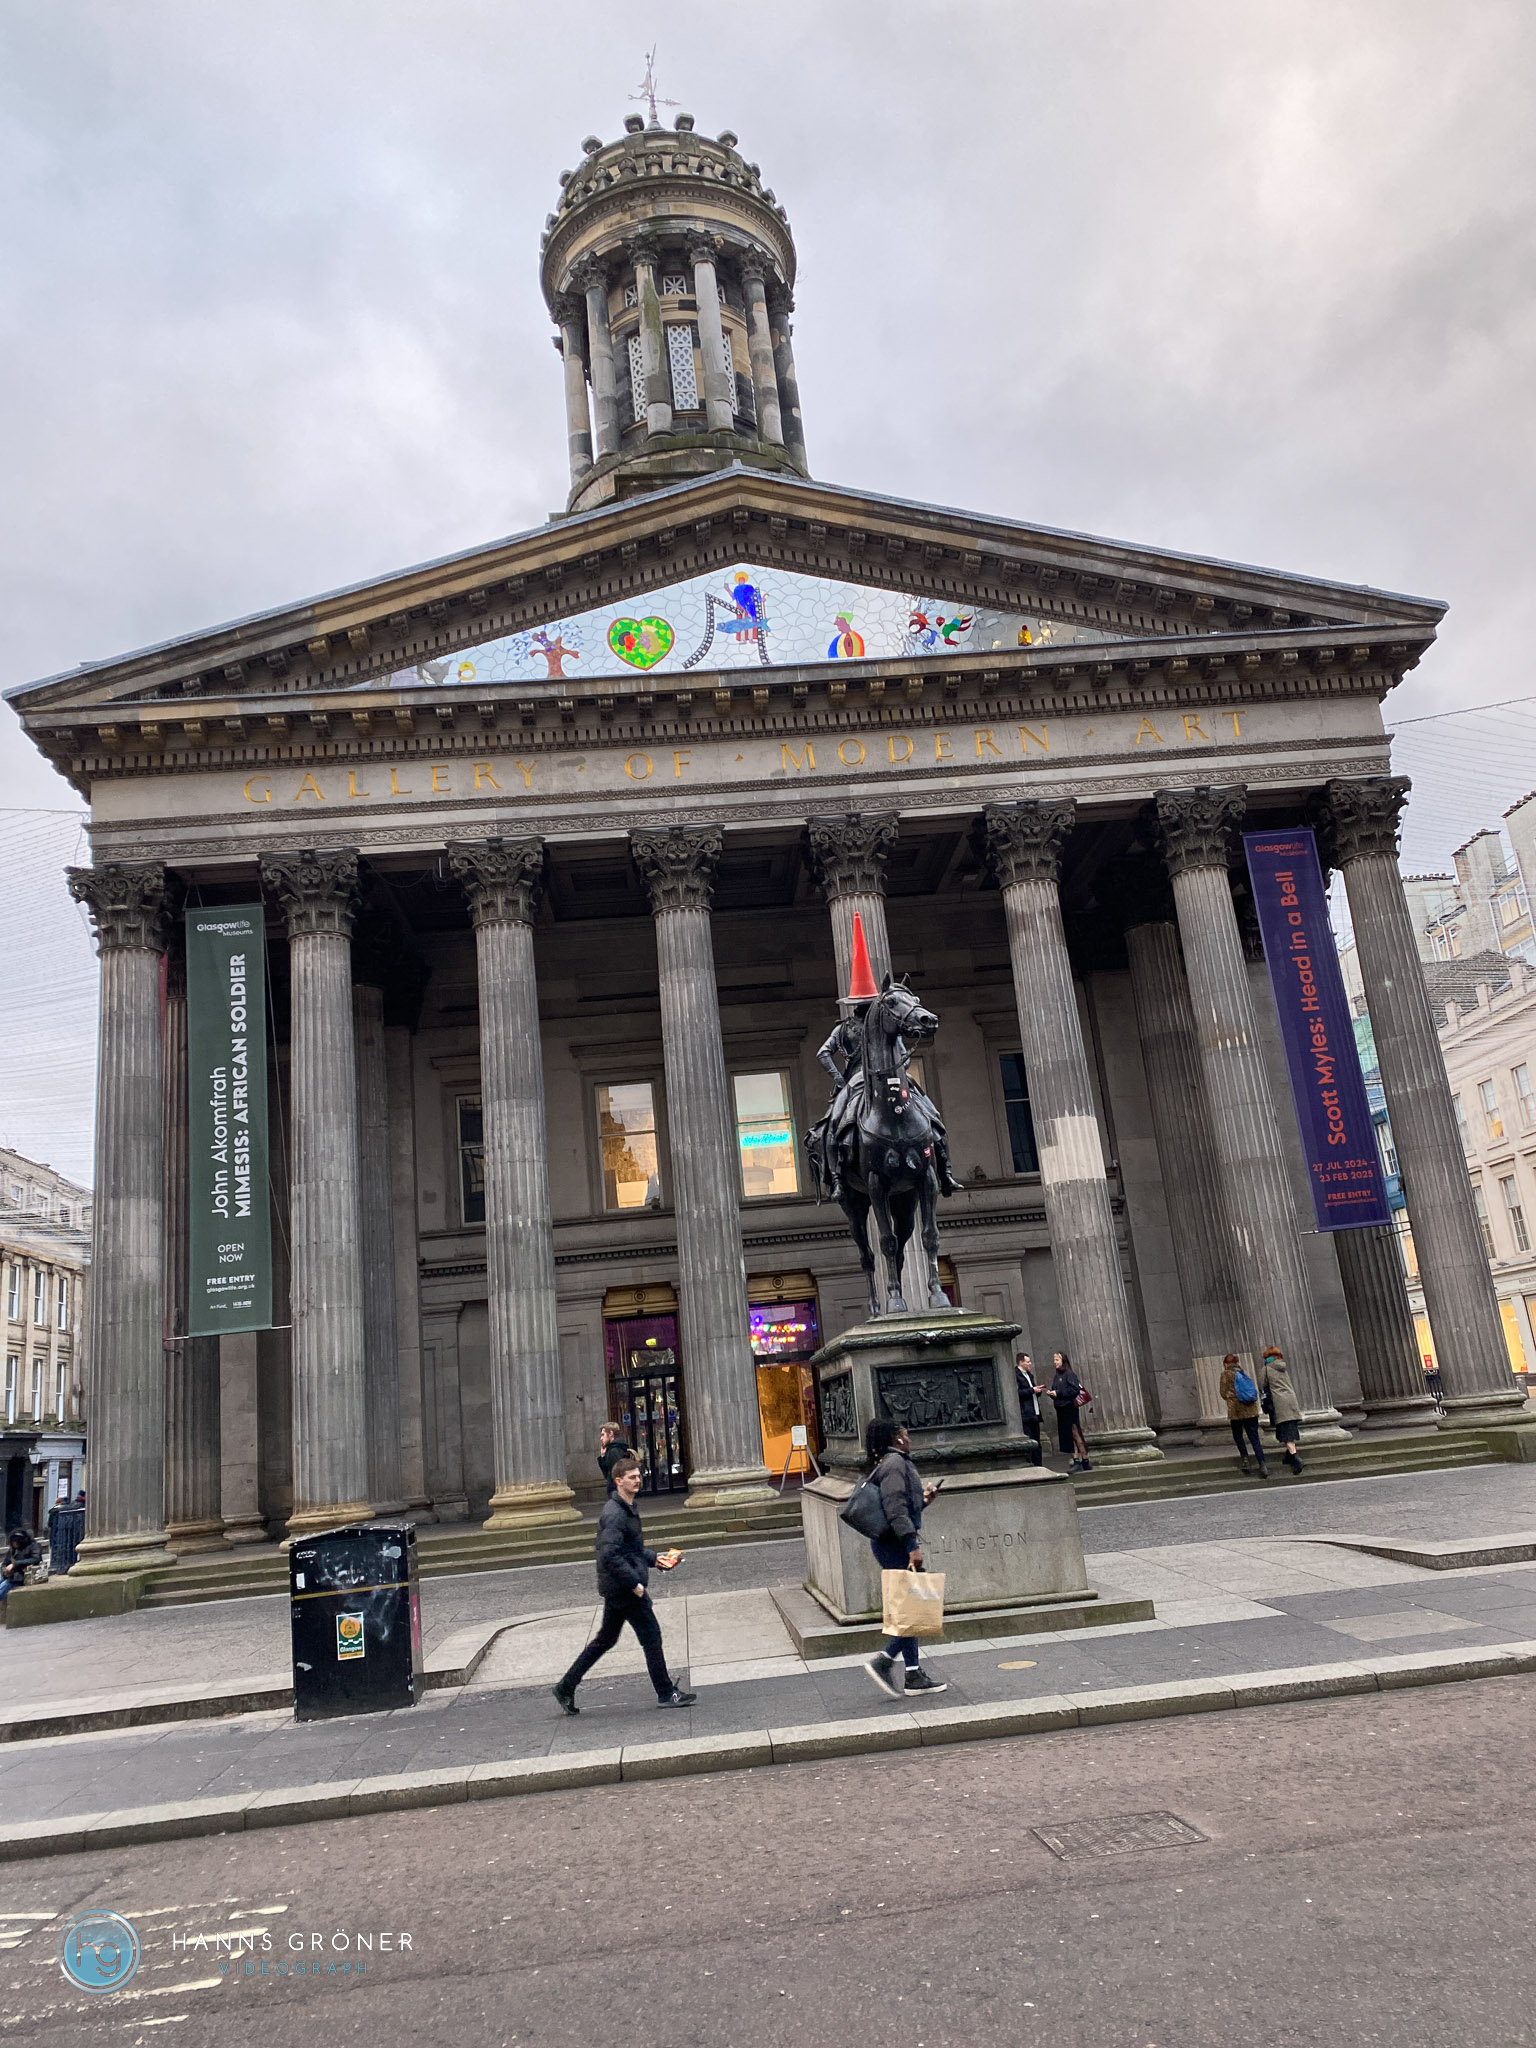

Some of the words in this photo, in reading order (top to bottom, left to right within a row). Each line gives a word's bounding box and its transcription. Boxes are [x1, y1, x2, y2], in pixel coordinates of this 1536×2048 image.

[243, 759, 539, 803] GALLERY
[625, 750, 692, 781] OF
[780, 724, 1051, 772] MODERN
[1134, 710, 1248, 745] ART
[1275, 871, 1299, 907] Bell
[222, 929, 254, 937] Museums
[1287, 911, 1303, 926] a
[1289, 931, 1308, 950] in
[230, 953, 247, 1033] SOLDIER
[1292, 955, 1320, 1012] Head
[1310, 1016, 1336, 1085] Myles:
[231, 1038, 249, 1124] AFRICAN
[209, 1066, 228, 1164] Akomfrah
[1321, 1089, 1347, 1145] Scott
[234, 1129, 251, 1218] MIMESIS:
[1312, 1163, 1323, 1172] 27
[1326, 1161, 1342, 1171] JUL
[1344, 1159, 1368, 1169] 2024
[1319, 1174, 1331, 1183] 23
[1332, 1172, 1349, 1181] FEB
[1350, 1169, 1374, 1180] 2025
[210, 1169, 229, 1219] John
[1327, 1192, 1346, 1200] FREE
[1347, 1189, 1371, 1199] ENTRY
[217, 1242, 245, 1253] OPEN
[219, 1253, 243, 1264] NOW
[206, 1277, 227, 1286] FREE
[228, 1274, 255, 1284] ENTRY
